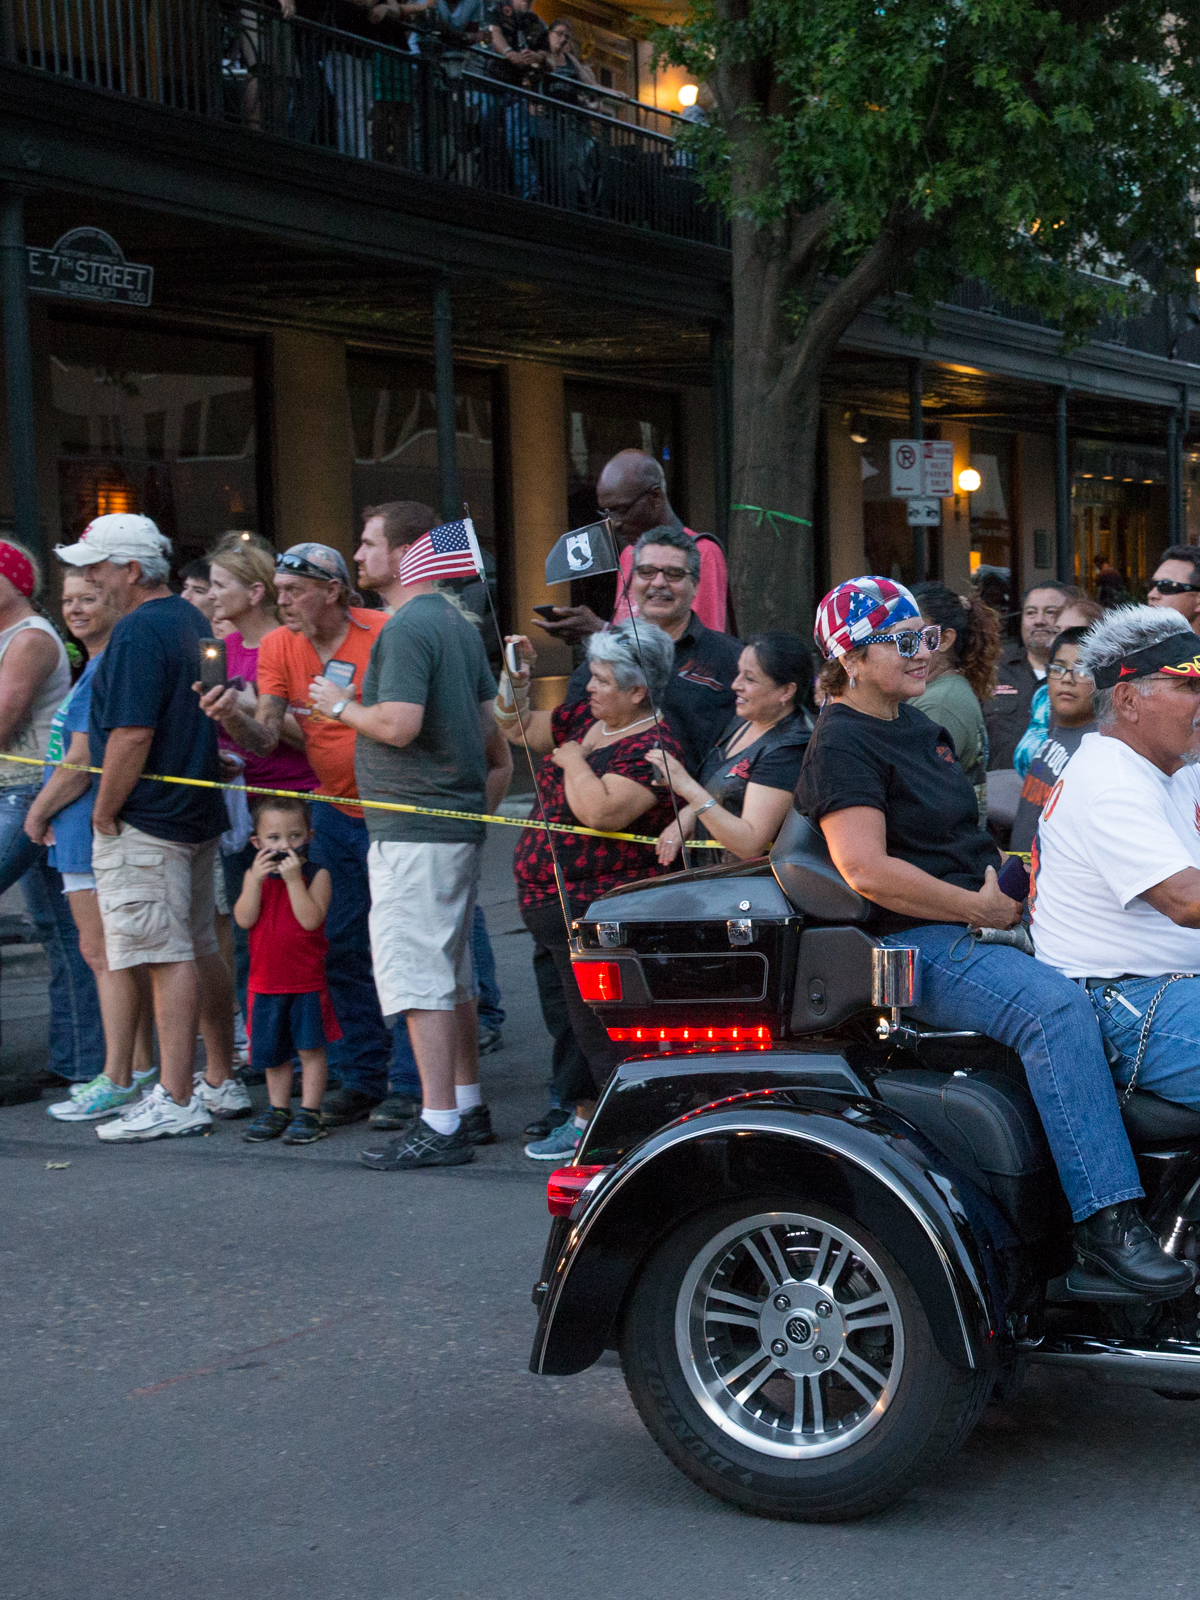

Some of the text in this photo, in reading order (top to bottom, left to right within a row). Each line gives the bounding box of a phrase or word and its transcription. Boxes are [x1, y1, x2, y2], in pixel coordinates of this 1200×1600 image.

[29, 252, 45, 275] E
[75, 260, 148, 291] STREET
[1043, 740, 1070, 776] YOU
